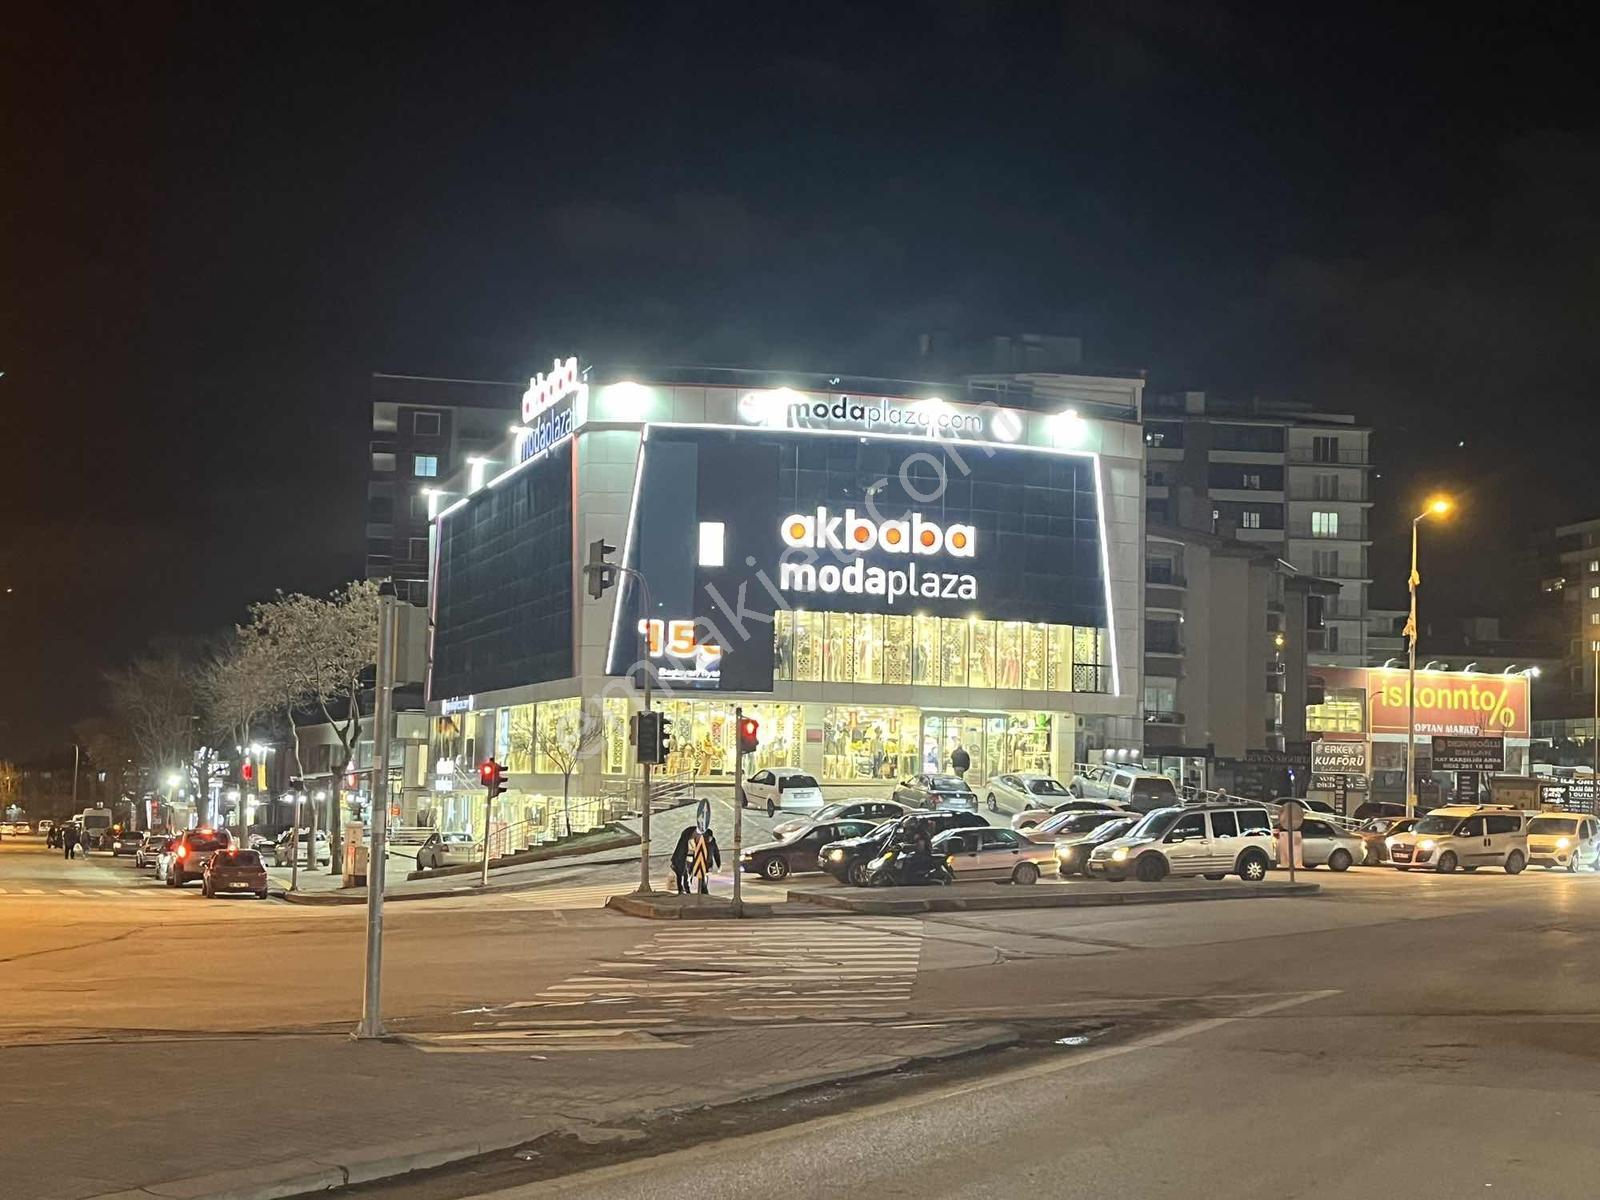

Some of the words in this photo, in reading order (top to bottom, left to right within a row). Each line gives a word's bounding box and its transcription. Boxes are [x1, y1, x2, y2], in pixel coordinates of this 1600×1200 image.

[788, 395, 983, 431] modaplazacom
[780, 506, 976, 557] akbaba
[780, 558, 977, 603] modaplaza
[1314, 755, 1365, 766] KUAFÖRÜ
[1324, 744, 1354, 754] ERKEK
